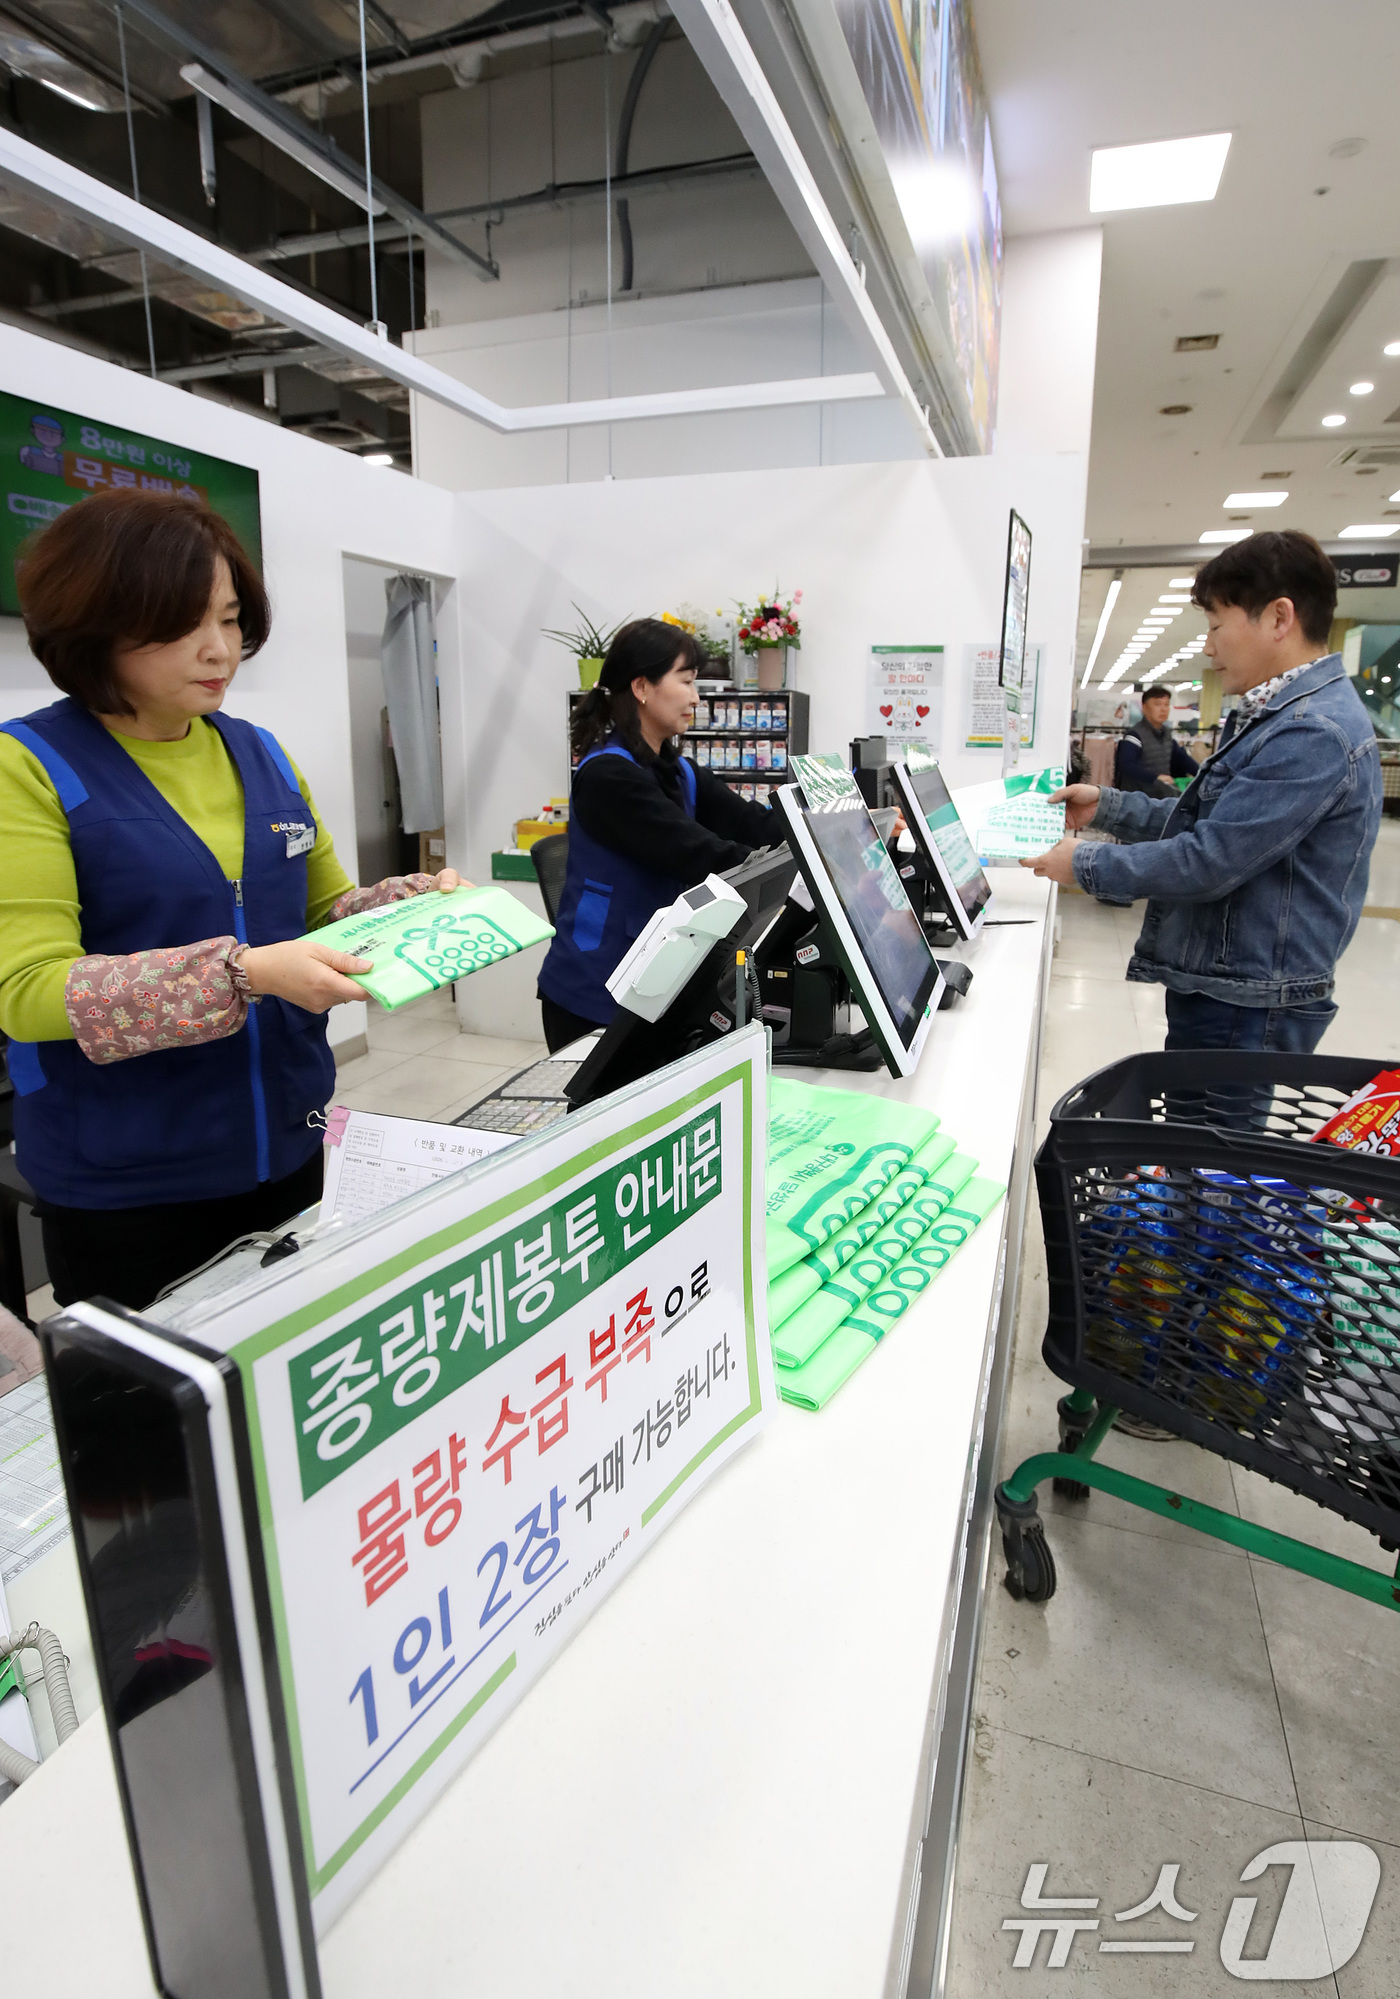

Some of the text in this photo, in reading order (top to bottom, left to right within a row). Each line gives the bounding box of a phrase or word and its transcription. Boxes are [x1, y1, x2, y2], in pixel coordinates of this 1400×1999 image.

[80, 426, 192, 478] 8만원 이상
[421, 1139, 436, 1151] 반품
[439, 1142, 447, 1152] 및
[450, 1144, 465, 1156] 교환
[468, 1147, 483, 1158] 내역
[789, 1153, 839, 1183] 대구광역시
[302, 1117, 720, 1462] 종량제봉투 안내문
[348, 1332, 737, 1747] 1인 2장 구매 가능합니다.
[352, 1432, 466, 1608] 물량
[481, 1351, 575, 1485] 수급
